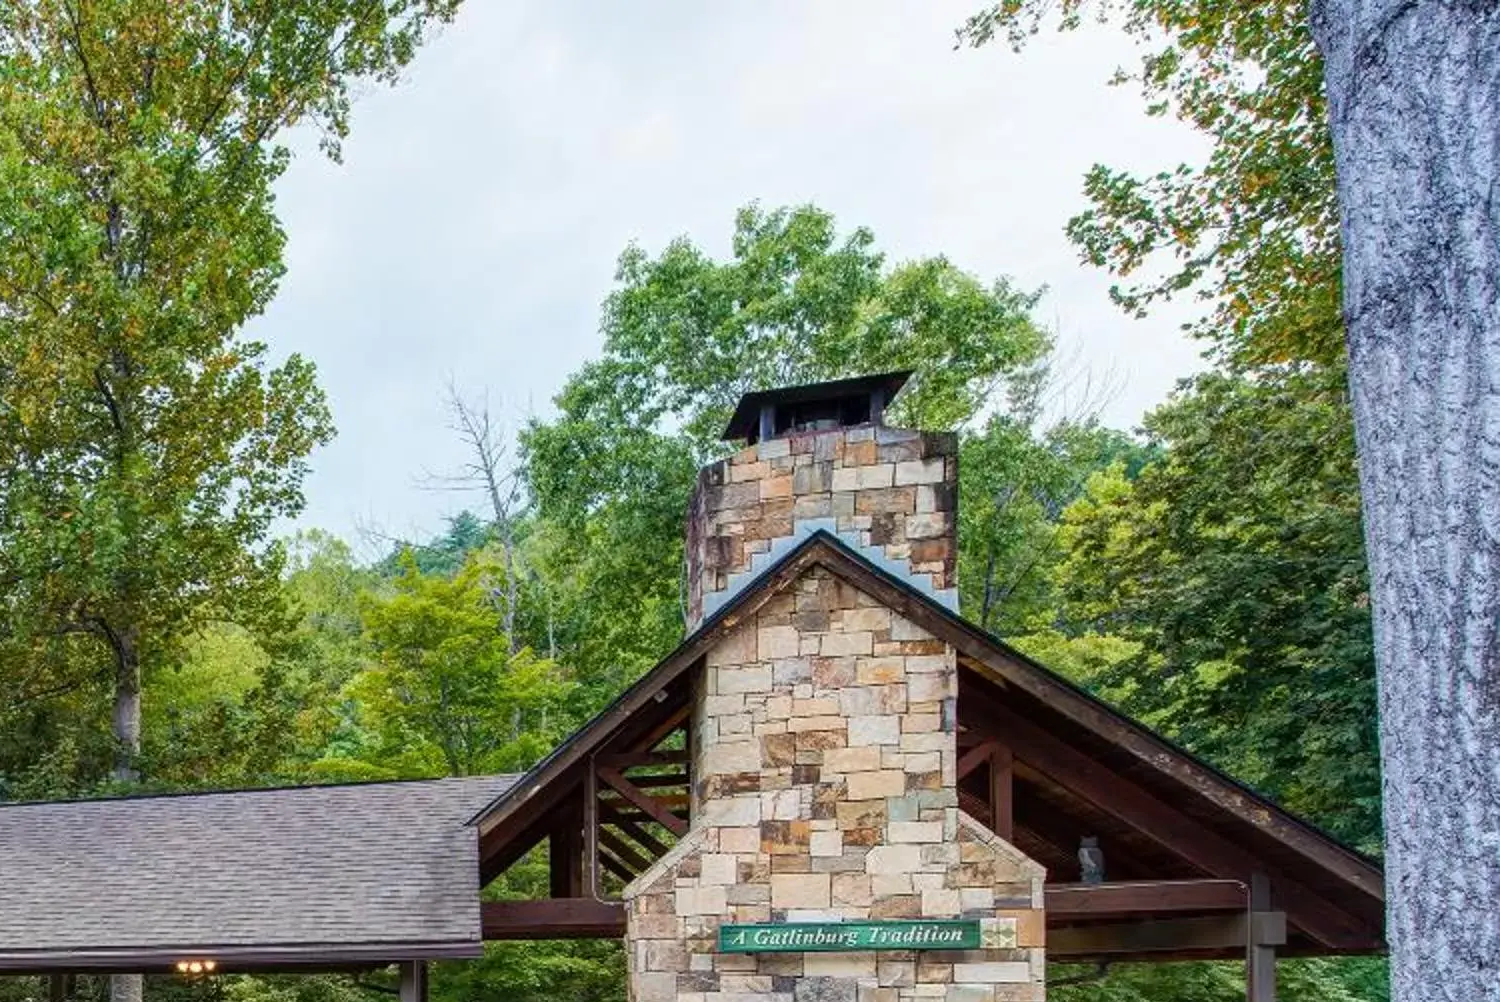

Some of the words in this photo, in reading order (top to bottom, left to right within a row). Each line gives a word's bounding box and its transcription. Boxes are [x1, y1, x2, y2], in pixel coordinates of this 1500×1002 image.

[731, 929, 745, 945] A
[754, 927, 858, 947] Gatlinburg
[868, 926, 963, 945] Tradition
